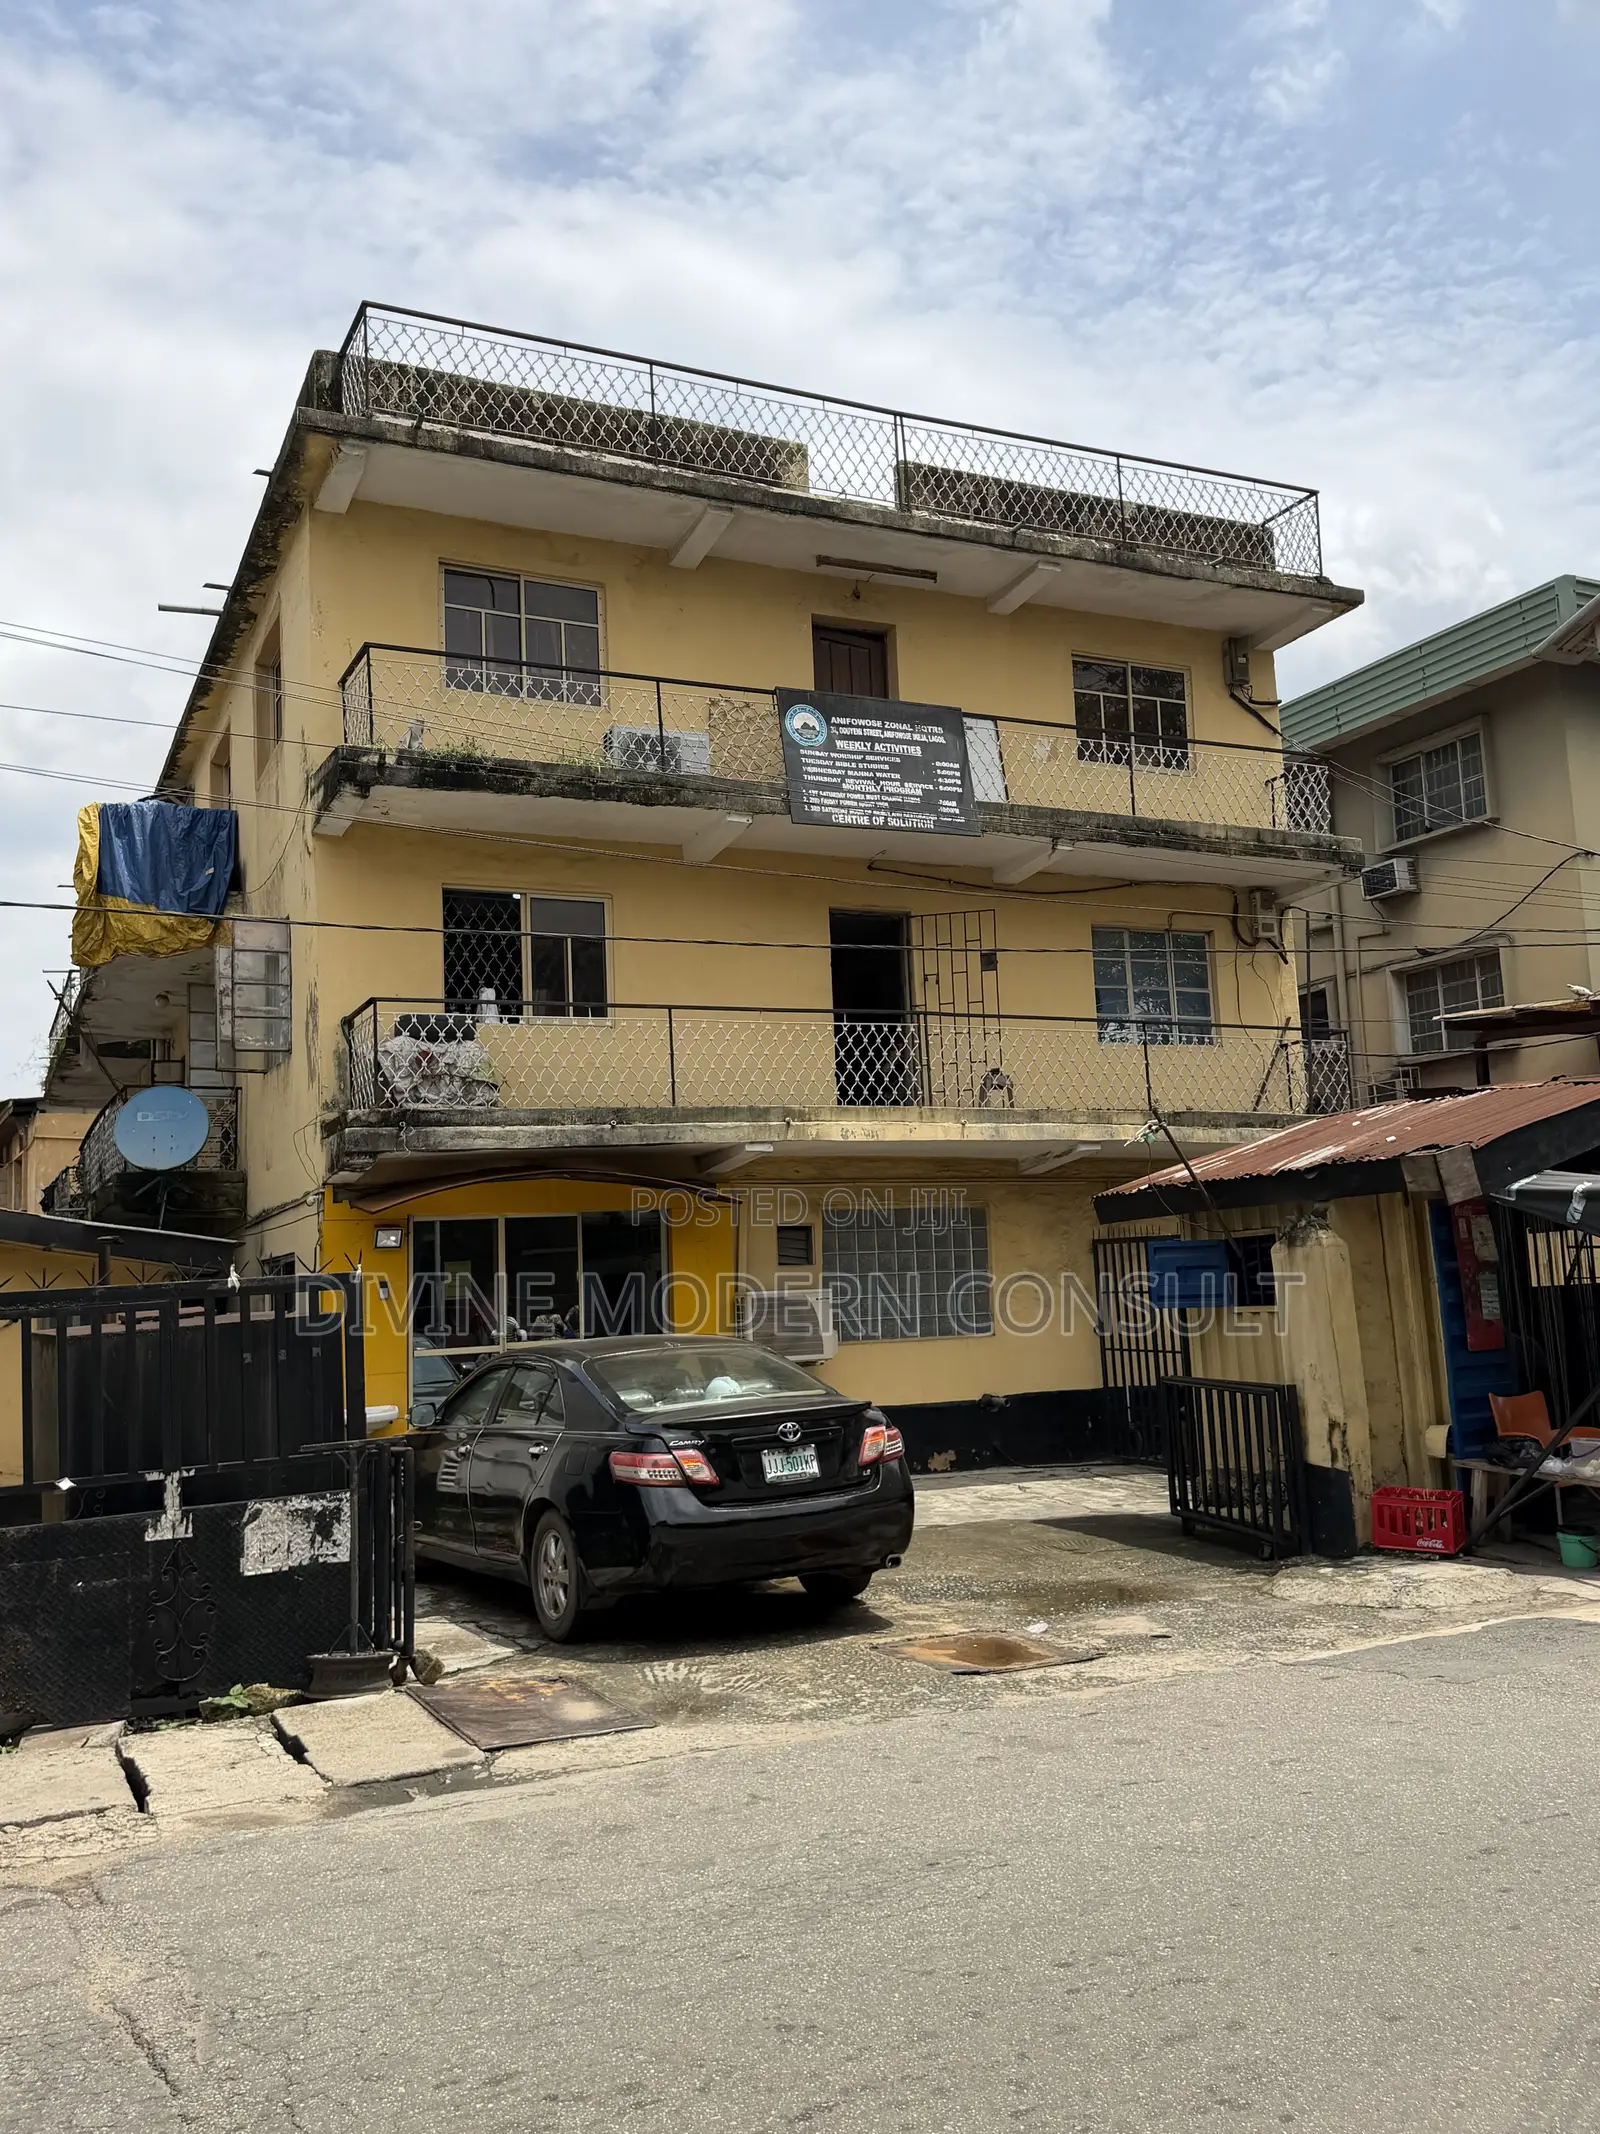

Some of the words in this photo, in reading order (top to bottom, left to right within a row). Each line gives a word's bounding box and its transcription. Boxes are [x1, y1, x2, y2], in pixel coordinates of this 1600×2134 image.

[830, 716, 882, 728] ANIFOWOSE
[884, 721, 913, 731] ZONAL
[835, 740, 871, 751] WEEKLY
[874, 742, 922, 755] ACTIVITIES
[800, 749, 829, 758] SUNDAY
[830, 752, 864, 760] WORSHIP
[865, 755, 901, 763] SERVICES
[801, 757, 834, 766] TUESDAY
[803, 774, 841, 783] THURSDAY
[845, 778, 876, 786] REVIVAL
[880, 780, 901, 788] HOUR
[904, 782, 934, 790] SERVICE
[847, 770, 874, 778] MANNA
[876, 772, 901, 780] WATER
[842, 783, 881, 793] MONTHLY
[883, 786, 923, 797] PROGRAM
[832, 814, 871, 826] CENTRE
[872, 816, 885, 826] OF
[887, 817, 935, 829] SOLUTION
